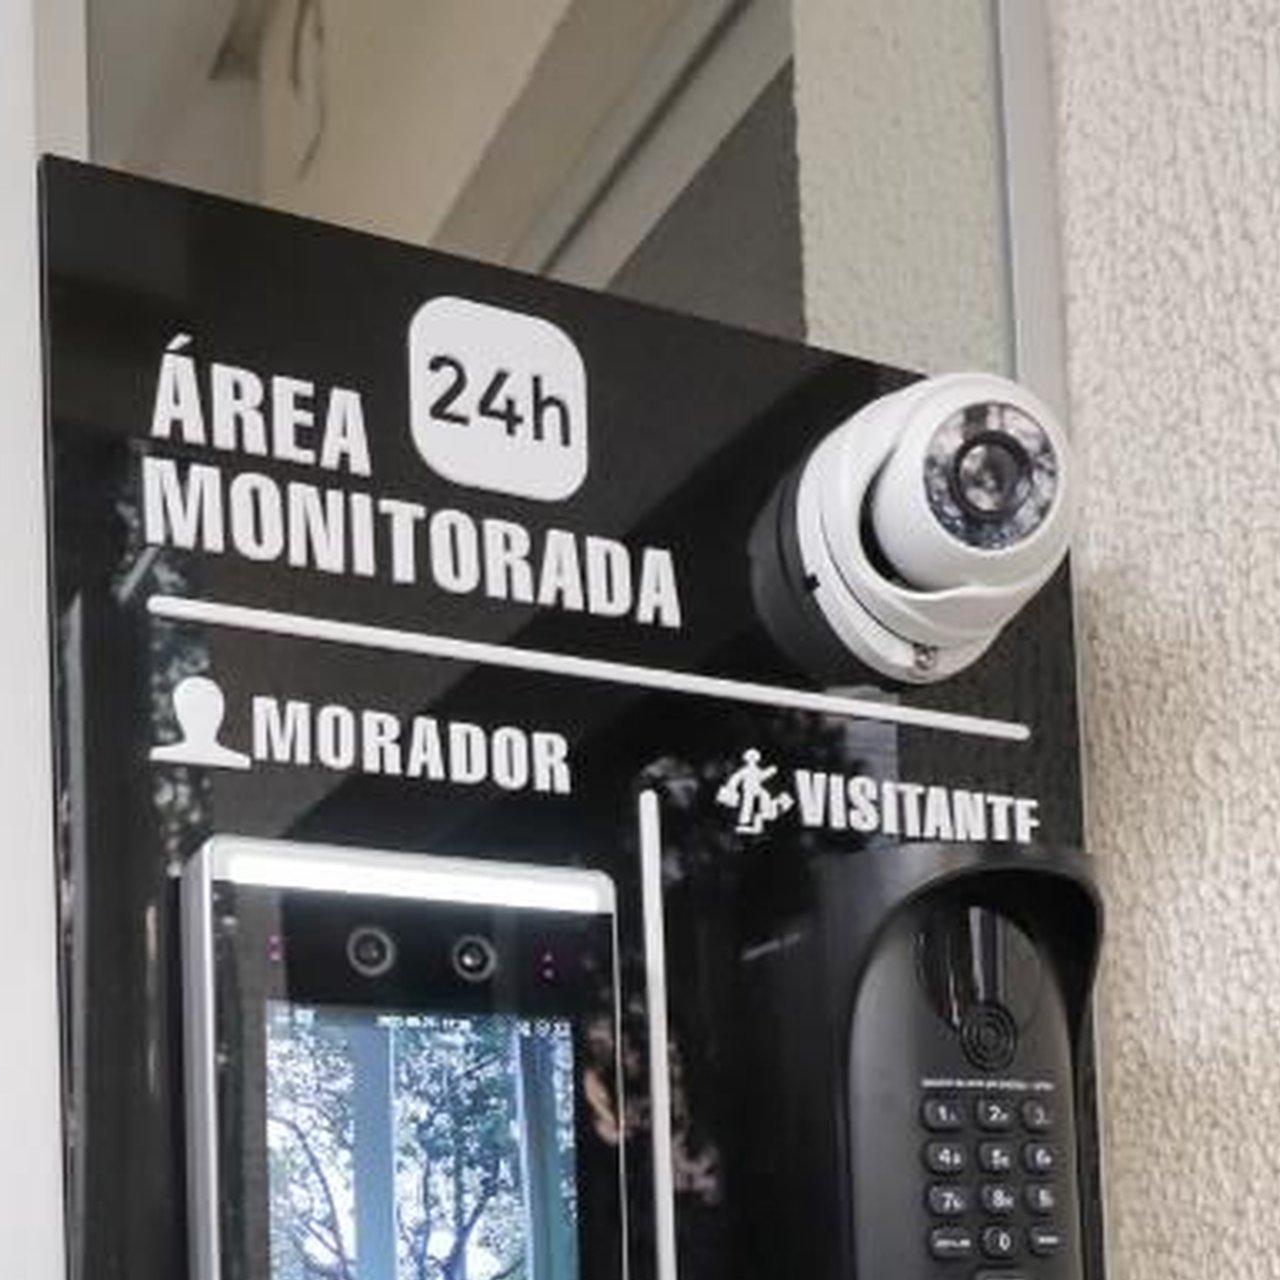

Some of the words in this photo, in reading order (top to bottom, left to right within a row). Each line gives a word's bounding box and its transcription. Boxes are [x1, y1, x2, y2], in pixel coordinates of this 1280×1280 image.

[151, 333, 371, 477] ÁREA
[428, 354, 571, 447] 24h
[142, 456, 681, 628] MONITORADA
[253, 696, 570, 794] MORADOR
